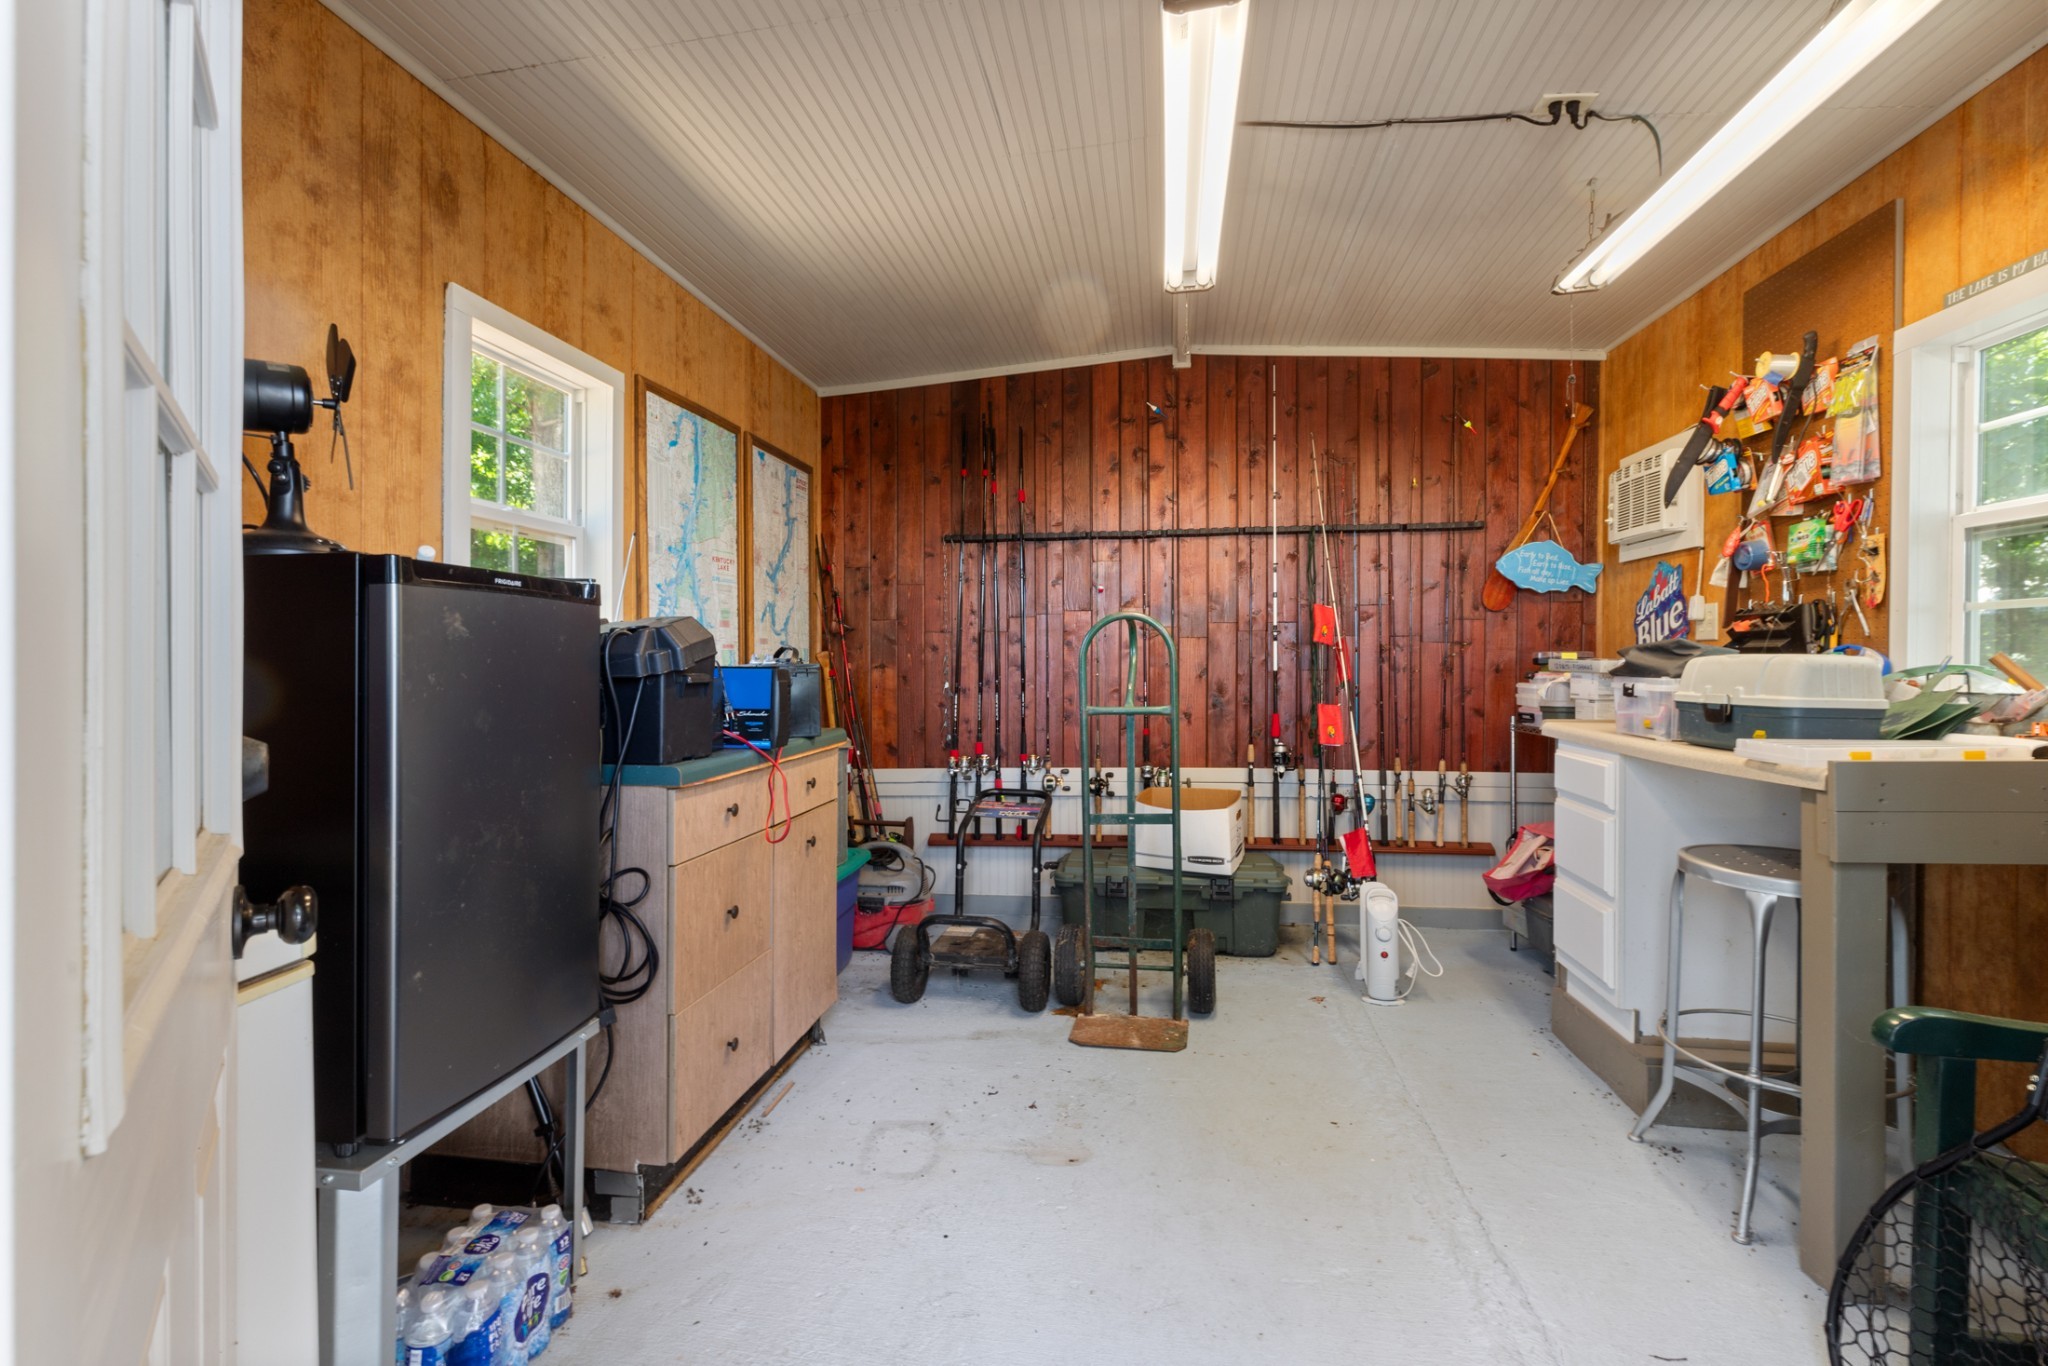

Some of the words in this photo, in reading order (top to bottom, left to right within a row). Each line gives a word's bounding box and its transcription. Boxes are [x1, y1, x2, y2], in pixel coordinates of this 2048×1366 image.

[1947, 287, 1965, 305] THE
[1968, 274, 1994, 295] LAKE
[1998, 268, 2008, 283] IS
[2012, 259, 2028, 277] MY
[1636, 570, 1679, 624] Labatt
[1638, 601, 1684, 645] Blue
[559, 1235, 569, 1248] 12
